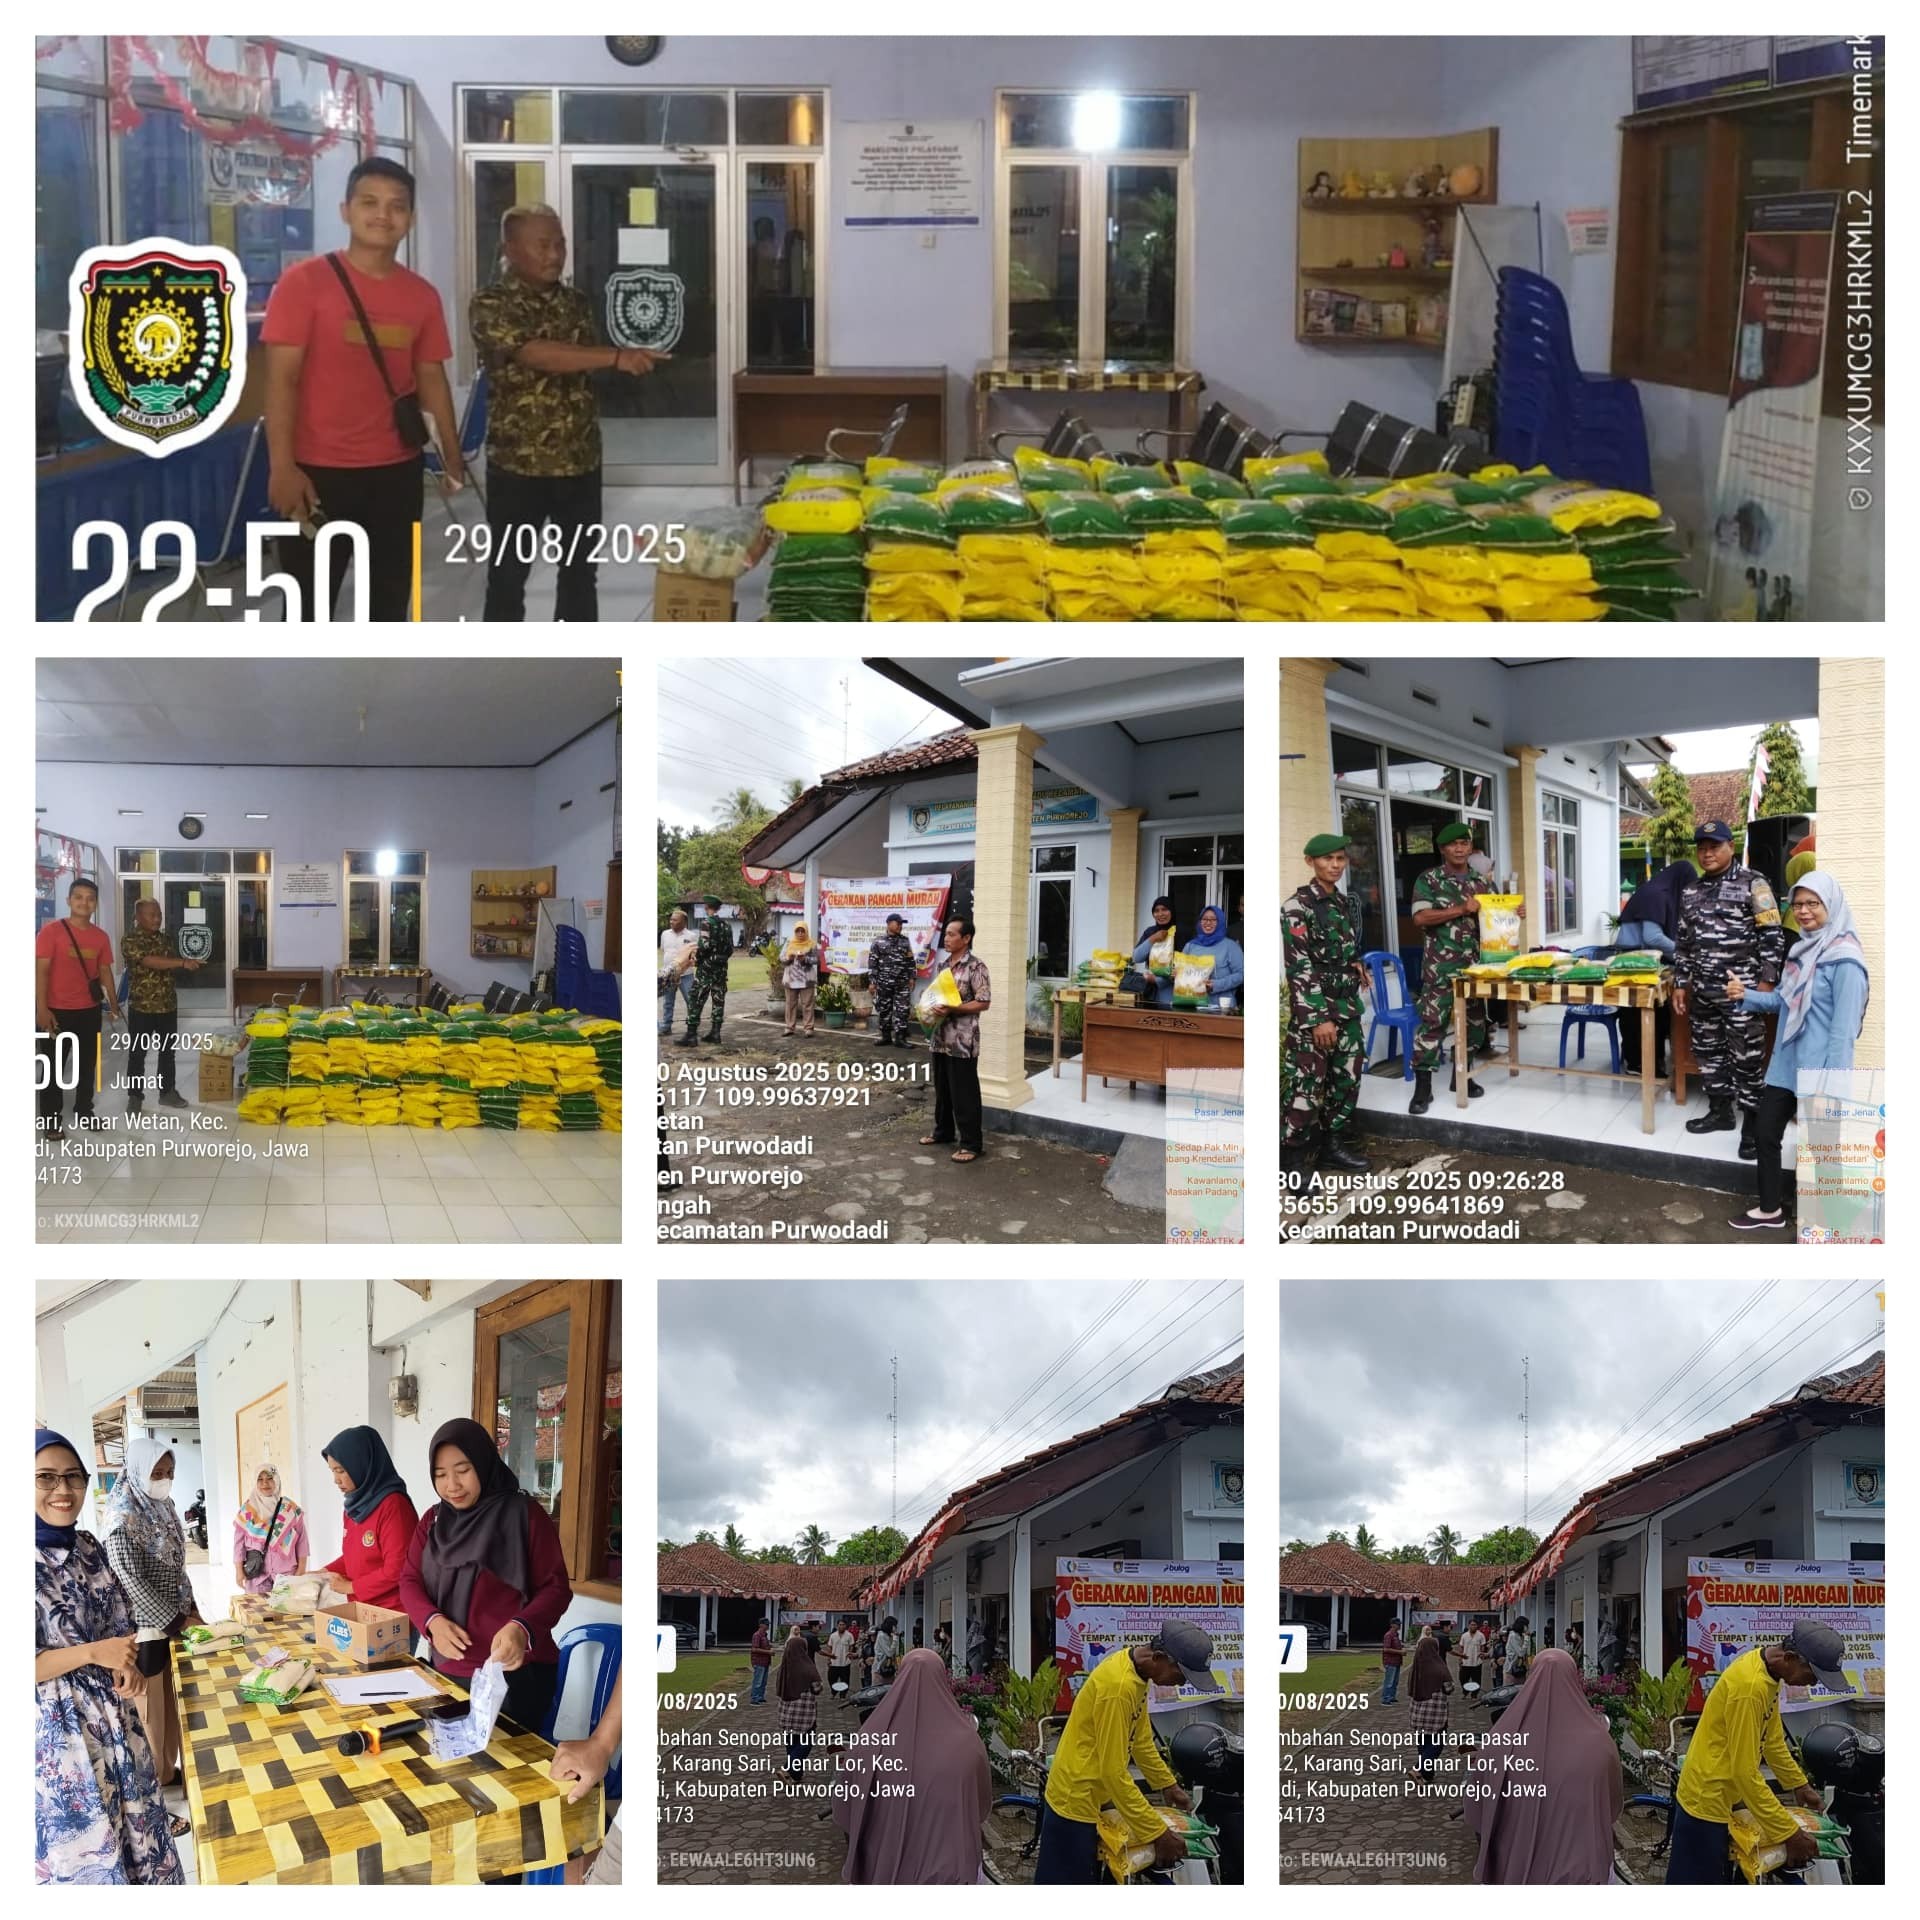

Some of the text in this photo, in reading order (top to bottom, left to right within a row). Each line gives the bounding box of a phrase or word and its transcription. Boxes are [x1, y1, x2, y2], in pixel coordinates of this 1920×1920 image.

[828, 890, 941, 908] GERAKAN PANGAN MURAH
[1168, 1564, 1190, 1573] bulog
[1800, 1564, 1821, 1573] bulog
[1072, 1583, 1149, 1605] GERAKAN
[1152, 1584, 1218, 1605] PANGAN
[1703, 1583, 1781, 1605] GERAKAN
[1783, 1584, 1850, 1605] PANGAN
[1081, 1634, 1115, 1642] TEMPAT
[1712, 1634, 1748, 1642] TEMPAT
[1217, 1644, 1240, 1652] 2025
[1848, 1644, 1872, 1652] 2025
